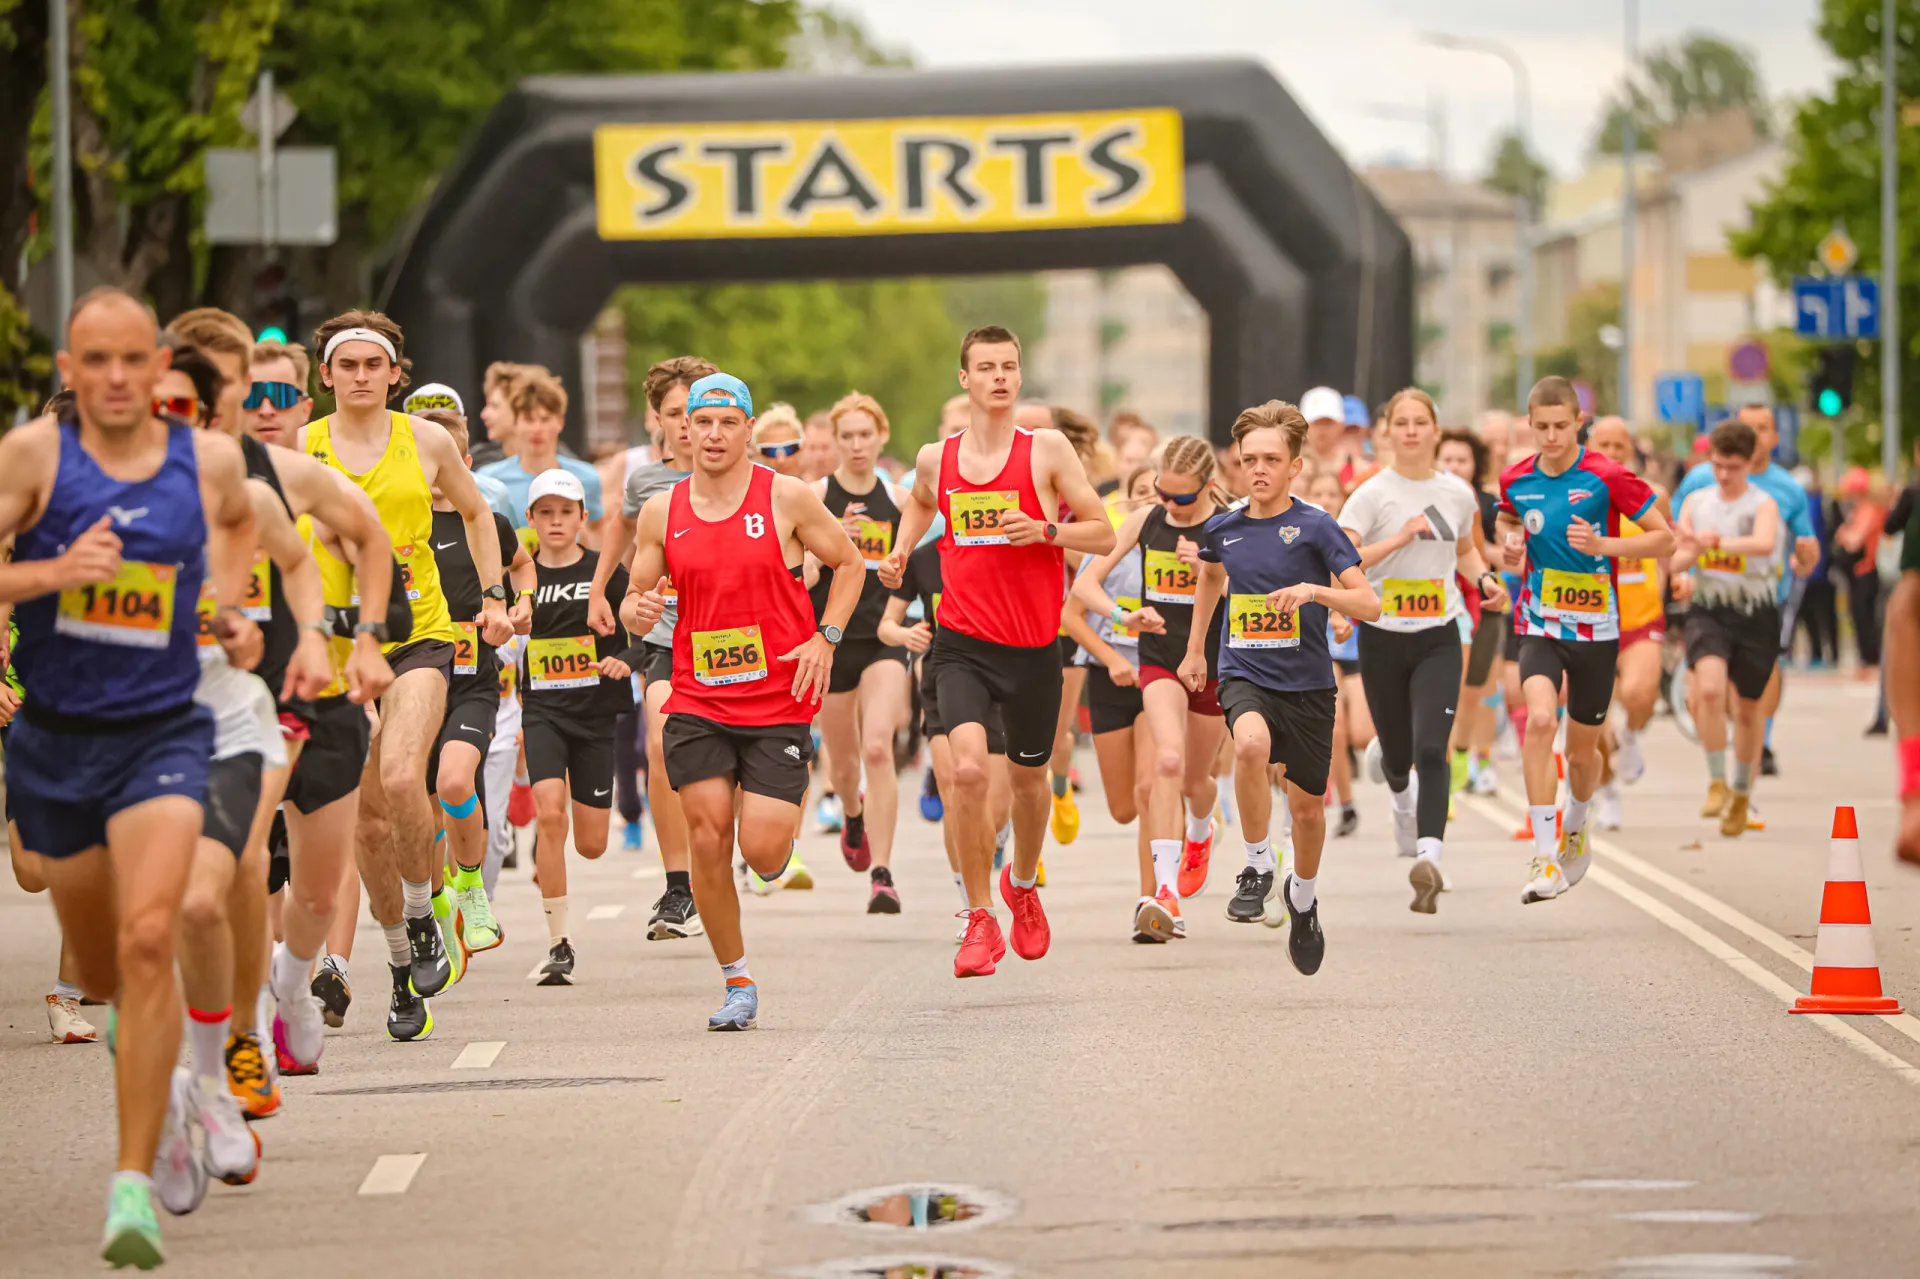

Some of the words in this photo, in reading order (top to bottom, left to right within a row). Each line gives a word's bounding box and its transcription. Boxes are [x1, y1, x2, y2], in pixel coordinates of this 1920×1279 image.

[636, 131, 1142, 217] STARTS
[960, 508, 1010, 529] 133
[81, 585, 161, 620] 1104
[1393, 594, 1439, 611] 1101
[1553, 586, 1603, 607] 1095
[1238, 612, 1293, 632] 1328
[539, 653, 591, 673] 1019
[703, 643, 758, 670] 1256
